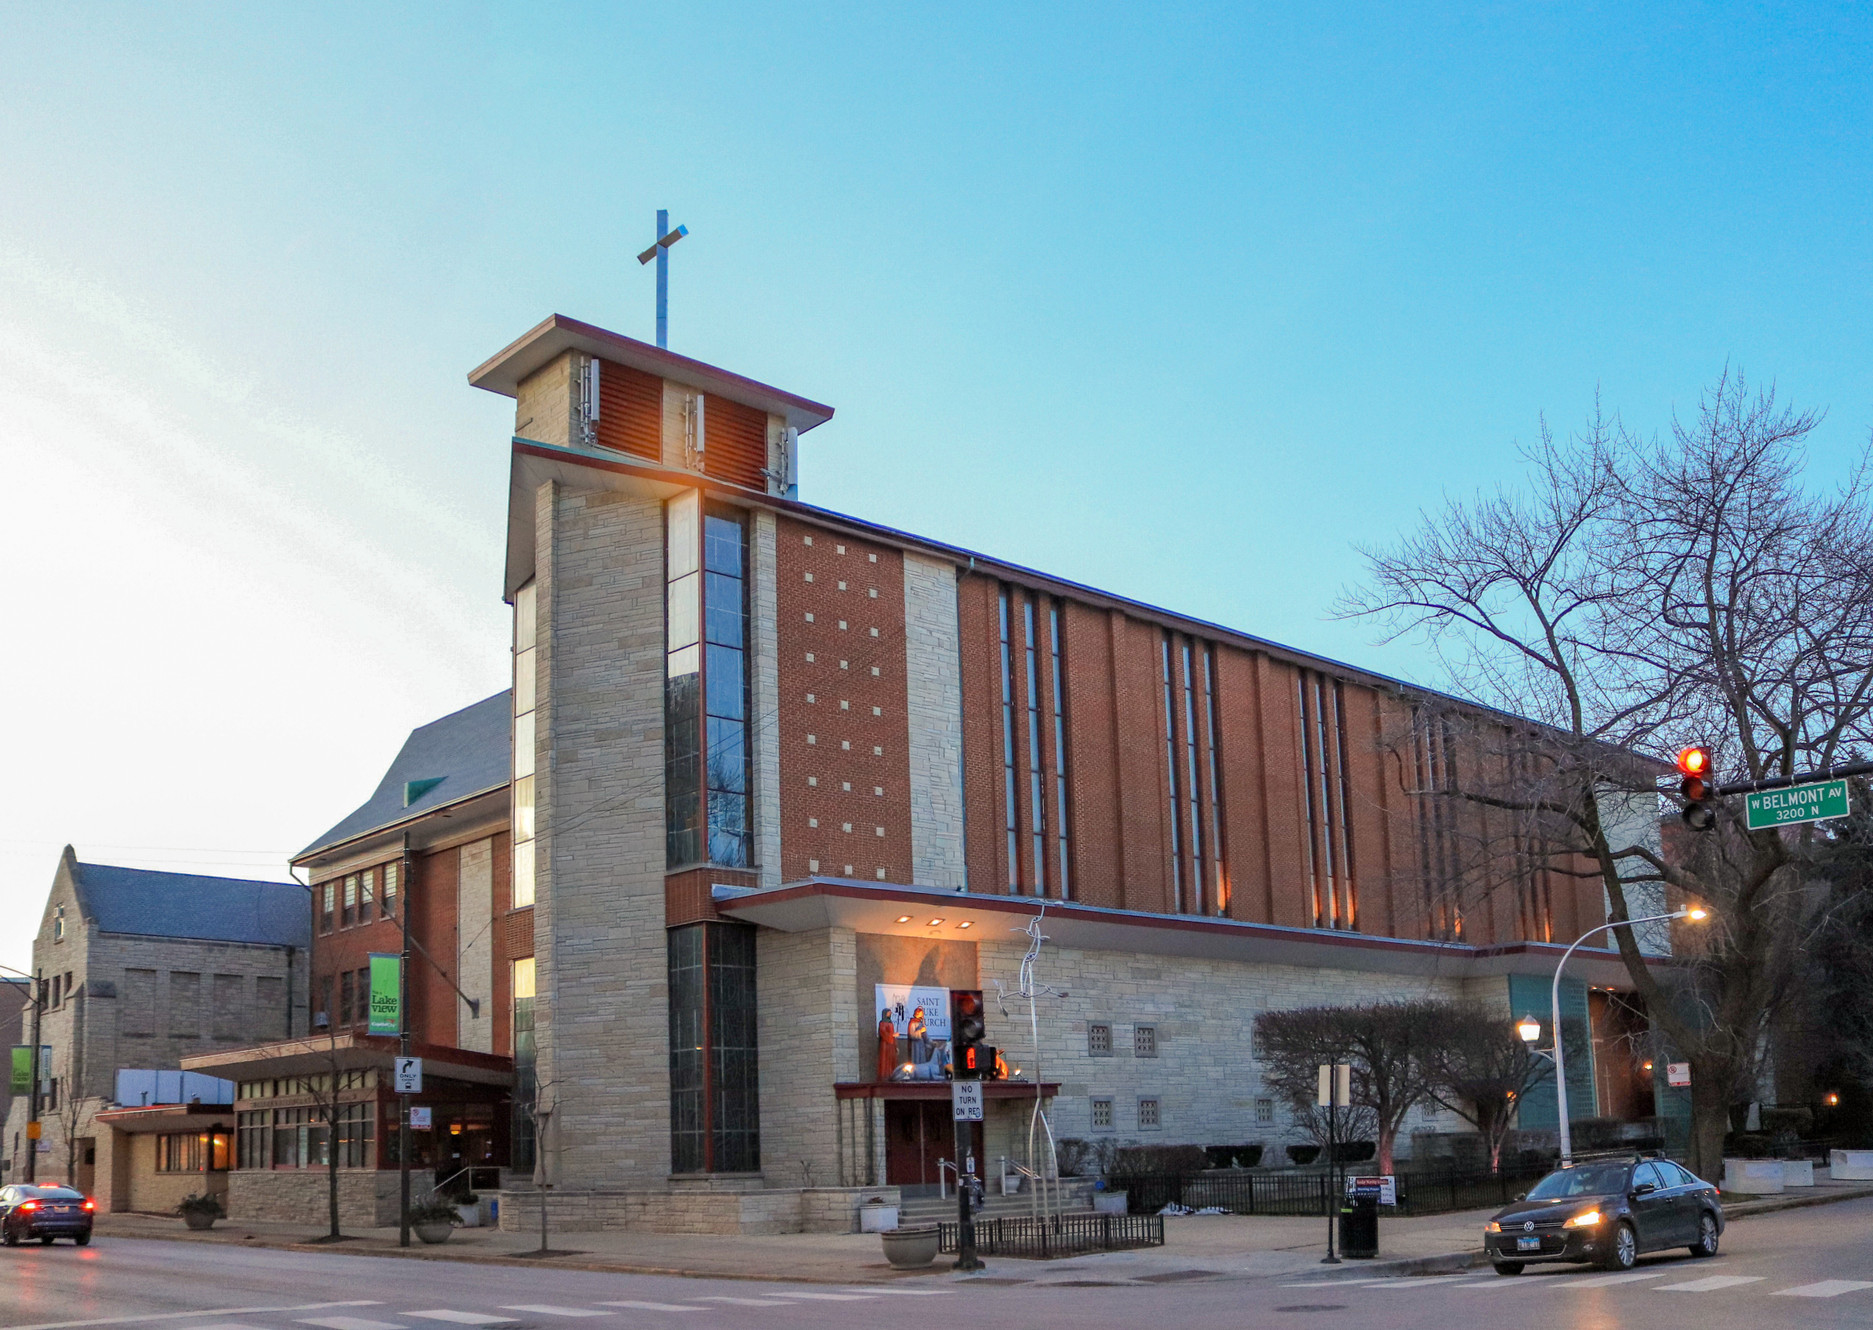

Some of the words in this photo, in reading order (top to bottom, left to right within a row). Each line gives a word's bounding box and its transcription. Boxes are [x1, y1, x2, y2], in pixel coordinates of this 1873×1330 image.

[1751, 799, 1760, 809] W
[1763, 788, 1825, 810] BELMONT
[1828, 786, 1842, 798] AV
[1776, 808, 1805, 820] 3200
[1811, 805, 1819, 816] N
[372, 995, 398, 1005] Lake
[917, 997, 940, 1006] SAINT
[371, 1005, 397, 1013] view
[921, 1007, 939, 1017] UKE
[922, 1018, 946, 1027] URCH
[961, 1085, 973, 1093] NO
[959, 1096, 977, 1104] TURN
[955, 1107, 965, 1116] ON
